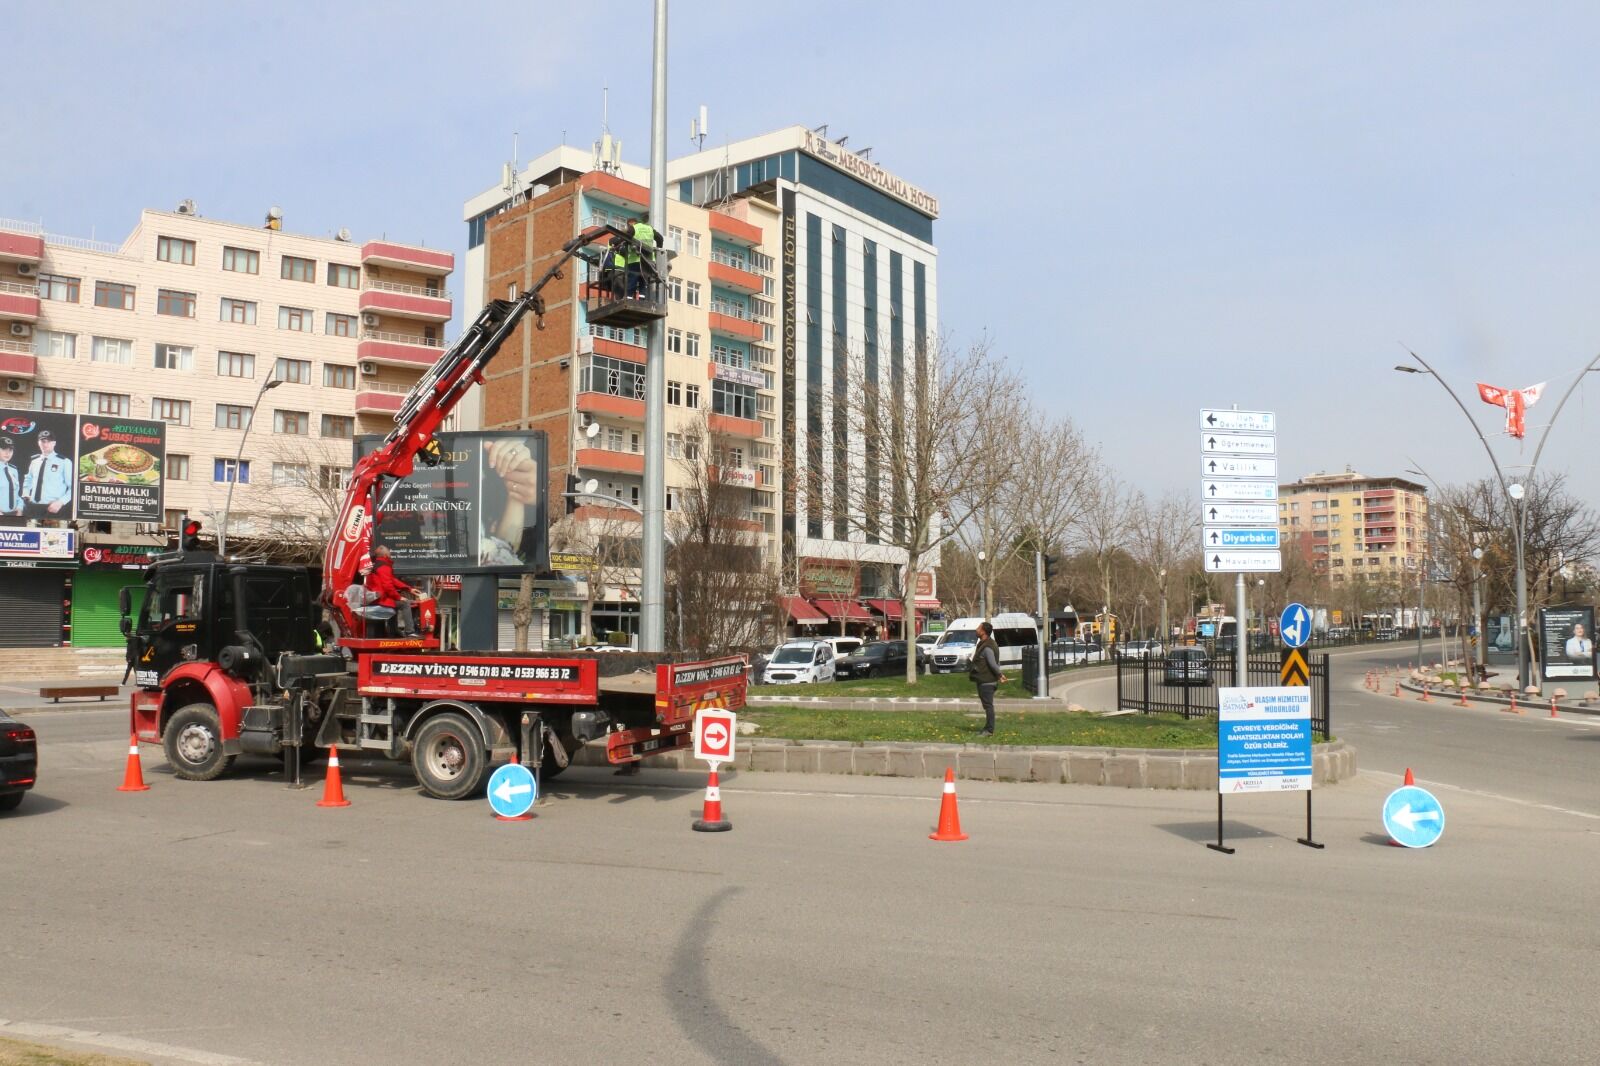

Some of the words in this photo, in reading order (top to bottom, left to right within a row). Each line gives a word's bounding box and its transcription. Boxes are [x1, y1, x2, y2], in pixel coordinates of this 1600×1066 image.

[839, 149, 909, 200] MESOPOTAMIA
[909, 187, 939, 215] HOTEL
[784, 214, 796, 268] HOTEL
[784, 273, 796, 394] MESOPOTAMIA
[112, 424, 158, 436] ADIYAMAN
[1223, 463, 1257, 471] Valilik
[84, 485, 121, 496] BATMAN
[123, 487, 150, 497] HALKI
[94, 496, 116, 504] TERCİH
[88, 503, 120, 511] TEŞEKKÜR
[420, 500, 472, 511] GÜNÜNÜZ
[1223, 533, 1275, 545] Diyarbakır
[1226, 557, 1275, 566] Havalimanı
[379, 640, 404, 648] DEZEN
[380, 663, 422, 675] DEZEN
[424, 662, 458, 677] VİNÇ
[459, 666, 465, 675] 0
[465, 666, 479, 676] 546
[490, 667, 499, 677] 83
[515, 667, 521, 678] 0
[520, 667, 535, 678] 533
[535, 667, 550, 679] 966
[550, 668, 560, 679] 33
[560, 668, 570, 679] 72
[1254, 695, 1276, 704] ULAŞIM
[1277, 694, 1309, 703] HİZMETLERİ
[1264, 704, 1300, 713] MÜDÜRLÜĞÜ
[1232, 725, 1261, 733] ÇEVREYE
[1262, 723, 1299, 731] VERDİĞİMİZ
[1228, 733, 1281, 741] RAHATSIZLIKTAN
[1243, 741, 1262, 749] ÖZÜR
[1263, 741, 1289, 749] DİLERİZ.
